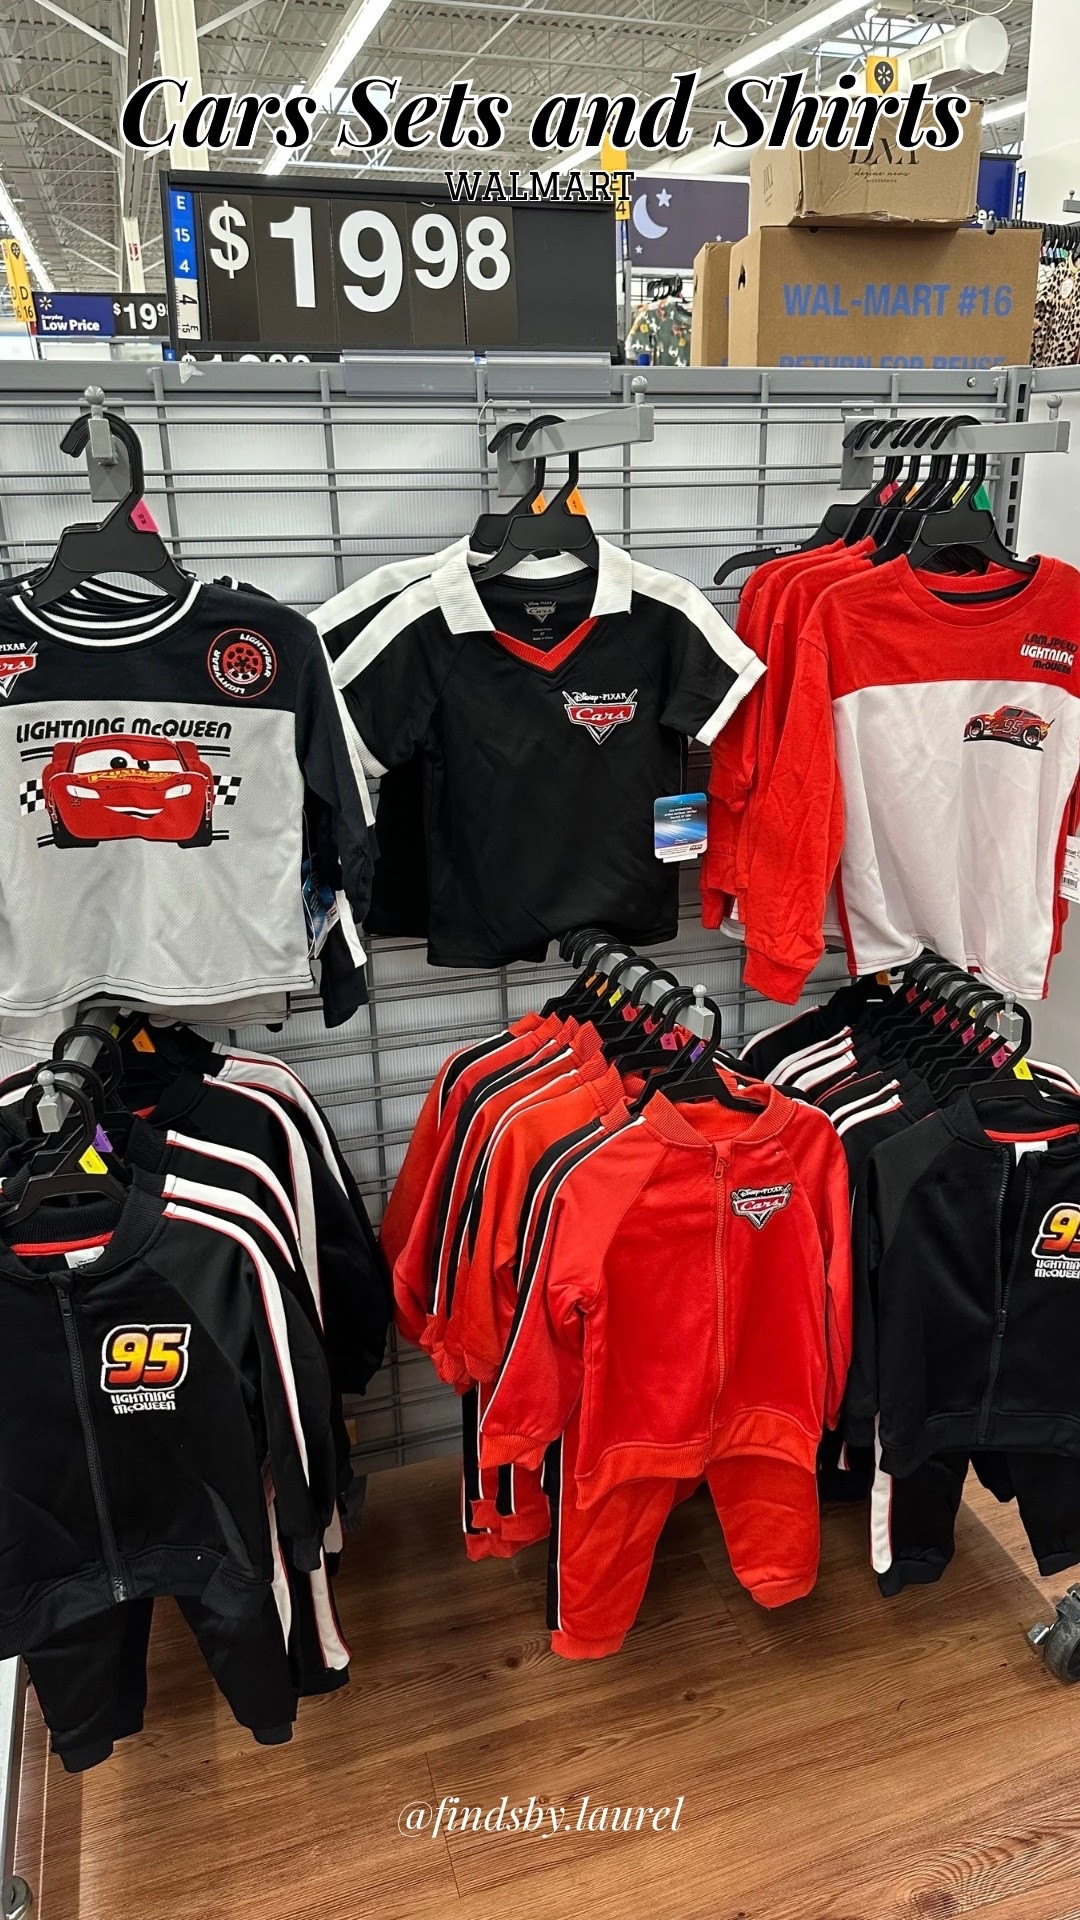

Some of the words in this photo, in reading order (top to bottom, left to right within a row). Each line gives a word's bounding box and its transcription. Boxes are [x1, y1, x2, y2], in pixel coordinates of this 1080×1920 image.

[176, 195, 187, 210] E
[616, 201, 627, 215] 4
[174, 228, 191, 242] 15
[179, 259, 190, 273] 4
[19, 286, 29, 300] D
[783, 284, 951, 317] WAL-MART
[958, 285, 1018, 317] #16
[23, 305, 34, 319] 16
[42, 320, 68, 331] Low
[69, 319, 100, 331] Price
[240, 633, 273, 678] LIGHTYEAR
[1020, 643, 1075, 666] LIGHTNING
[211, 649, 246, 695] LIGHTYEAR
[571, 691, 598, 703] Disney
[602, 691, 628, 701] PIXAR
[576, 708, 628, 720] Cars
[16, 717, 125, 743] LIGHTNING
[1001, 718, 1023, 735] 95
[740, 1198, 783, 1211] Cars
[1036, 1259, 1080, 1271] LIGHTNIN
[106, 1329, 186, 1387] 95
[110, 1390, 176, 1404] LIGHTNING
